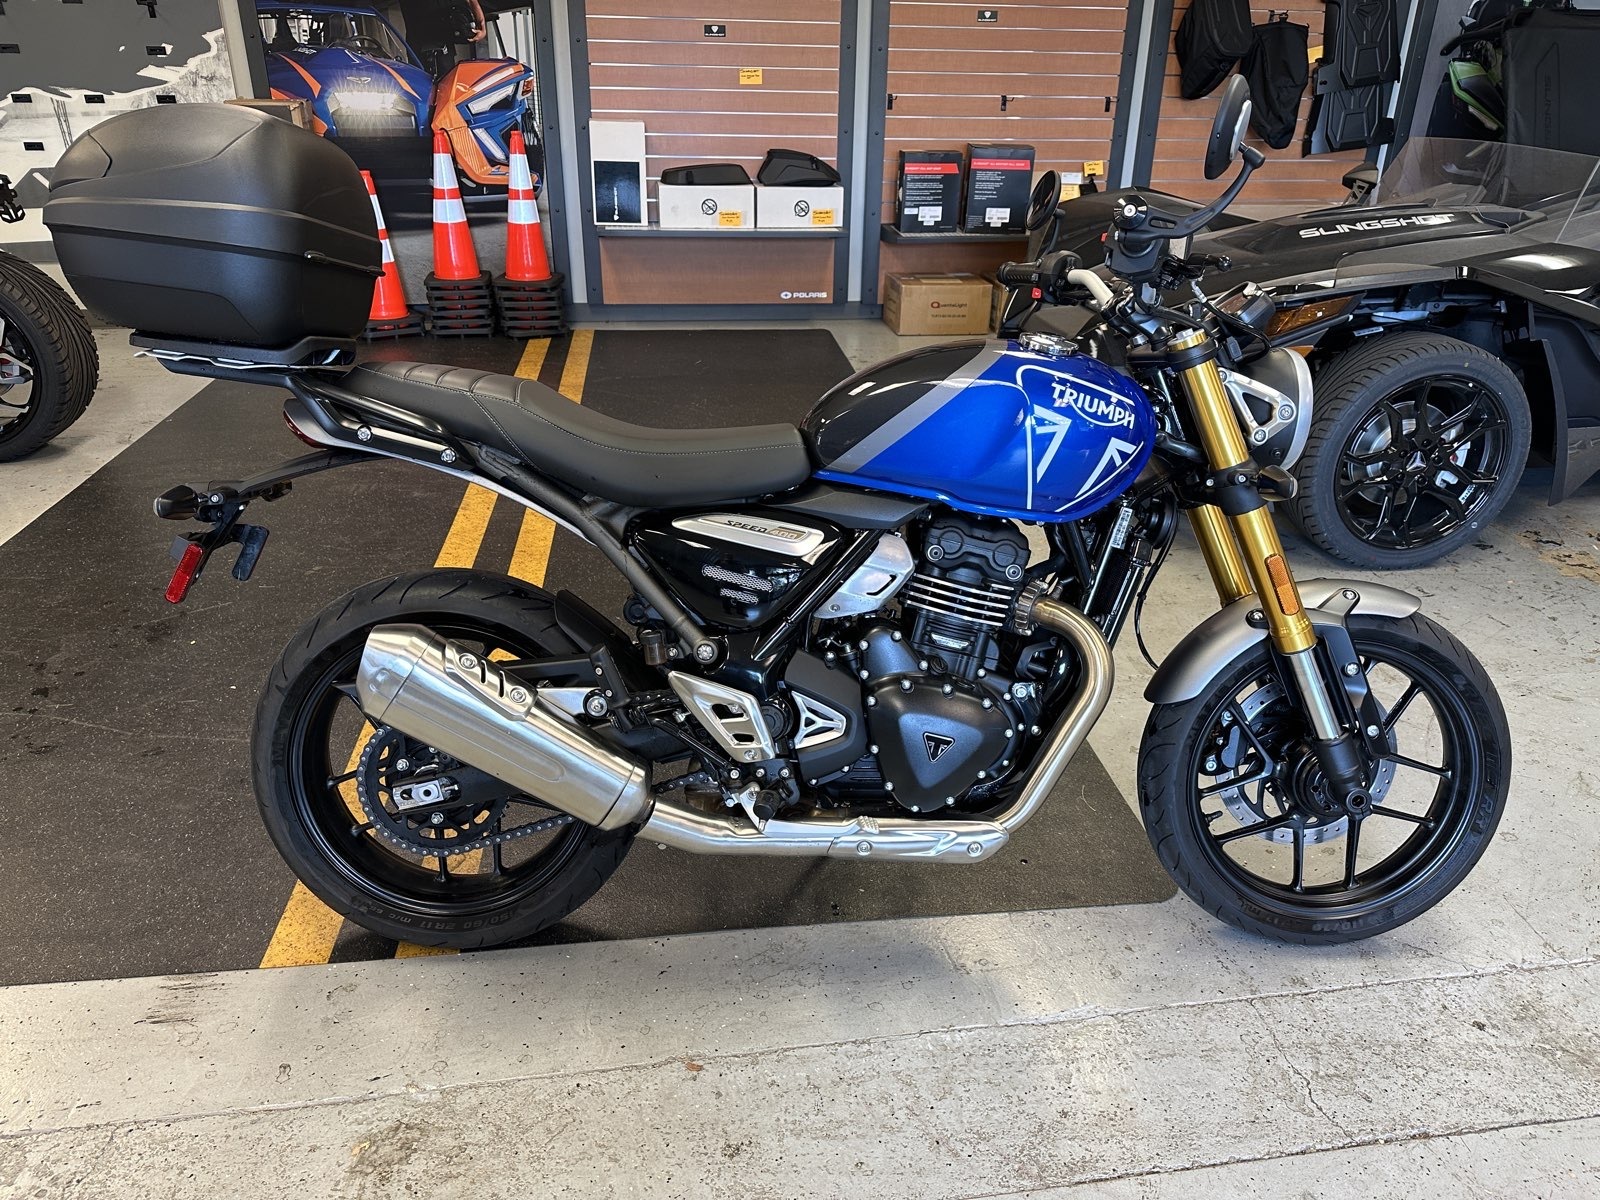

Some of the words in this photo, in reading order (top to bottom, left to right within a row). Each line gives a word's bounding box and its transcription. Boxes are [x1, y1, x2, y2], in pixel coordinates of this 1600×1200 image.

[1299, 213, 1455, 239] SLINGSHOT
[793, 291, 828, 299] POLARIS
[1051, 382, 1135, 430] TRIUMPH
[725, 520, 768, 533] SPEED
[769, 528, 798, 540] 400
